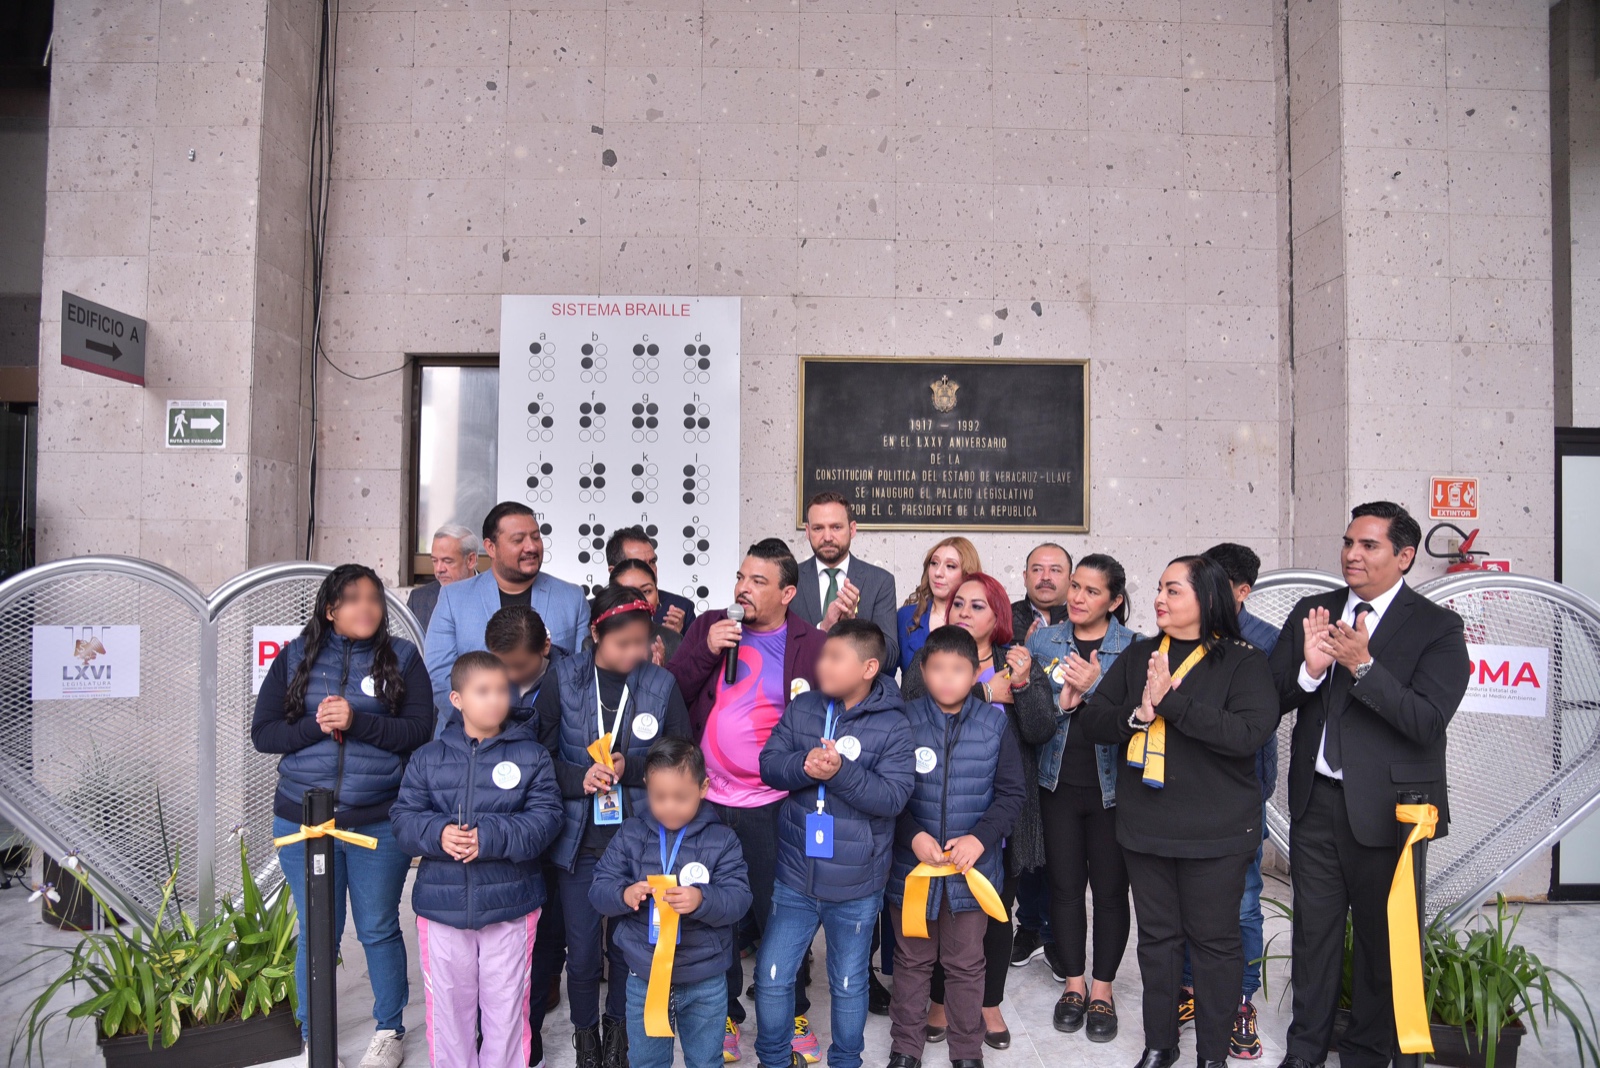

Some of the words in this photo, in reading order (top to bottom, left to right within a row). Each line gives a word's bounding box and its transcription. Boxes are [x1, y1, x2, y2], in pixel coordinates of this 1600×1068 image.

[552, 303, 620, 316] SISTEMA
[626, 304, 690, 317] BRAILLE
[68, 303, 124, 338] EDIFICIO
[130, 327, 139, 343] A
[540, 332, 546, 341] a
[592, 331, 598, 341] b
[642, 334, 649, 342] c
[695, 332, 701, 342] d
[537, 392, 544, 400] e
[592, 390, 596, 400] f
[642, 393, 649, 403] g
[694, 392, 700, 402] h
[910, 420, 933, 431] 1917
[958, 420, 980, 432] 1992
[883, 436, 894, 447] EN
[901, 436, 910, 447] EL
[917, 436, 942, 448] LXXV
[949, 437, 1007, 448] ANIVERSARIO
[643, 452, 648, 462] k
[931, 453, 941, 464] DE
[949, 454, 960, 464] LA
[816, 469, 873, 480] CONSTITUCION
[878, 469, 916, 481] POLITICA
[922, 470, 937, 481] DEL
[943, 470, 974, 482] ESTADO
[981, 471, 990, 482] DE
[855, 487, 865, 498] SE
[872, 487, 914, 498] INAUGURO
[920, 488, 930, 499] EL
[937, 488, 972, 499] PALACIO
[978, 488, 1033, 500] LEGISLATIVO
[872, 504, 881, 515] EL
[888, 504, 896, 515] C.
[901, 504, 952, 516] PRESIDENTE
[957, 505, 967, 516] DE
[974, 505, 984, 516] LA
[991, 505, 1037, 517] REPUBLICA
[535, 512, 544, 520] m
[589, 513, 595, 521] n
[642, 512, 647, 522] ñ
[587, 574, 593, 584] q
[63, 665, 111, 680] LXVI
